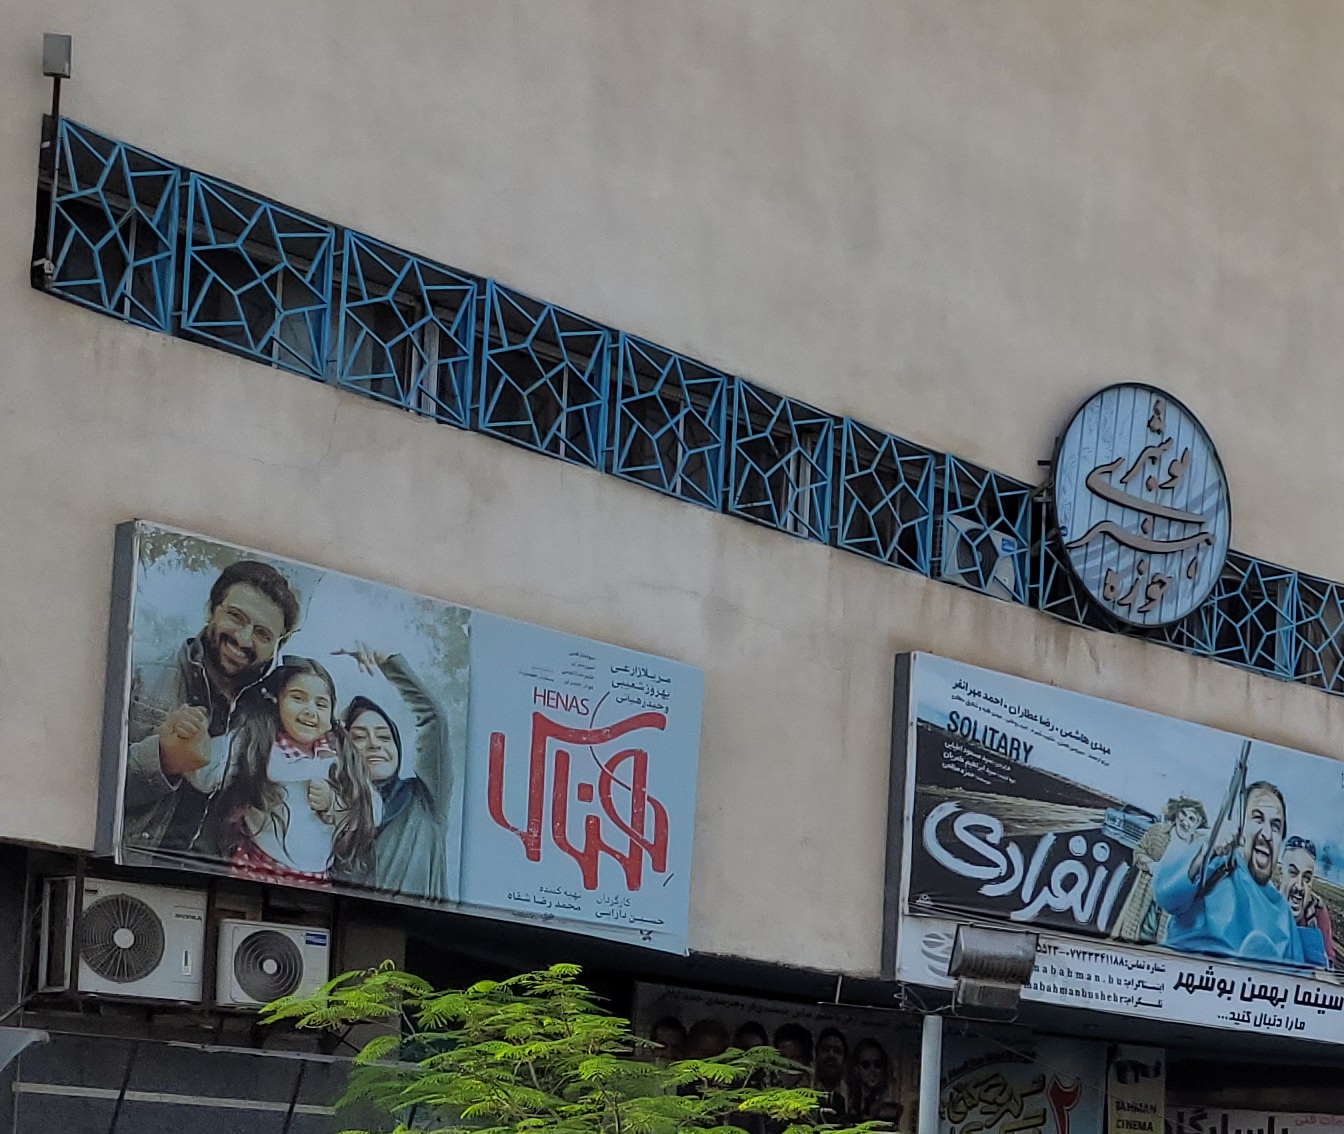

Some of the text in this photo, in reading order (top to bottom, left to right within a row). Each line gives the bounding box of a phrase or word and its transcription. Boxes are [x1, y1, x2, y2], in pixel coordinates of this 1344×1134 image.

[533, 686, 590, 716] HENAS
[982, 693, 1004, 707] احمد
[1008, 704, 1039, 722] عطاران
[1038, 715, 1055, 732] رضا
[946, 710, 1035, 763] SOLITARY
[1059, 729, 1090, 745] هاشمی
[1090, 740, 1111, 756] مهدی
[924, 800, 1133, 932] انفرادی
[533, 895, 552, 909] رضا
[554, 901, 581, 912] محمد
[1146, 963, 1166, 974] شماره
[1172, 965, 1344, 1015] سینما بهمن بوشهر
[1217, 1009, 1306, 1032] مارا دنبال کنید...
[1116, 1119, 1154, 1132] CINEMA
